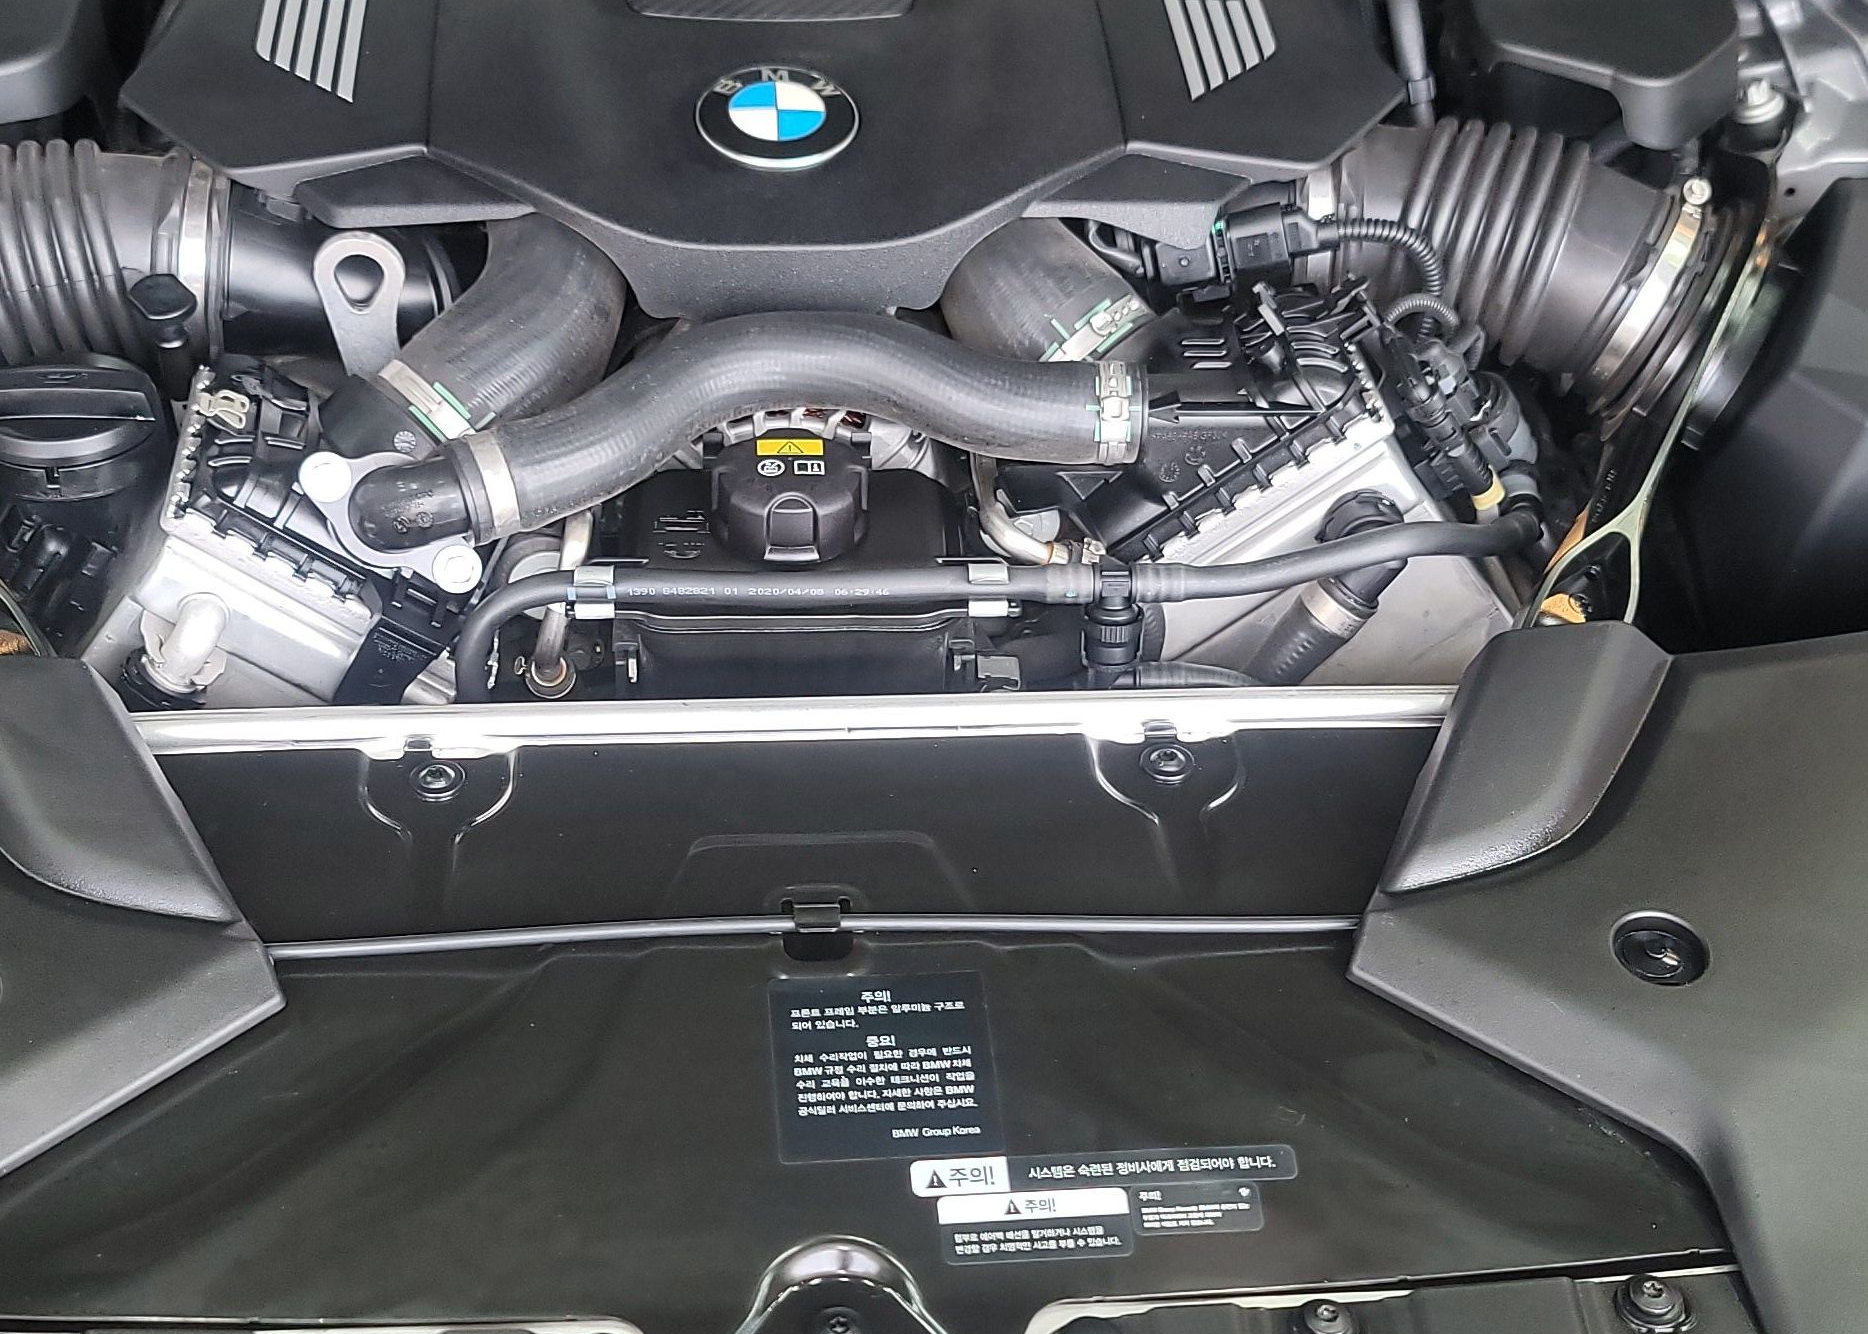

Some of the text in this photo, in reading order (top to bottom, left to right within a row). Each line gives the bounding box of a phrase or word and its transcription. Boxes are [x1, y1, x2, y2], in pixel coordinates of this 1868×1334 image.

[713, 68, 842, 97] BMW
[724, 587, 738, 595] 01
[861, 990, 890, 1003] 주의!
[790, 1001, 965, 1017] 프론트 프레임 부분은 알루미늄 구조로
[791, 1019, 859, 1031] 되어 있습니다.
[866, 1035, 896, 1047] 중요!
[794, 1046, 972, 1063] 차체 수리작업이 필요한 경우에 반드시
[794, 1059, 972, 1076] BMW 규정 수리 절차에 따라 BMW 차체
[796, 1072, 975, 1090] 수리 교육을 이수한 테크니션이 작업을
[797, 1085, 975, 1103] 진행하여야 합니다. 자세한 사항은 BMW
[798, 1105, 836, 1117] 공식딜러
[838, 1103, 895, 1114] 서비스센터에
[897, 1100, 935, 1111] 문의하여
[892, 1125, 981, 1138] BMW Group Korea
[948, 1154, 1276, 1188] 주의! 시스템은 숙련된 정비사에게 점검되어야 합니다.
[1025, 1198, 1056, 1213] 주의!
[1072, 1226, 1105, 1236] 시스템을
[1000, 1241, 1031, 1252] 치명적인
[1033, 1240, 1057, 1250] 사고를
[1076, 1238, 1086, 1247] 수
[1087, 1236, 1122, 1247] 있습니다.
